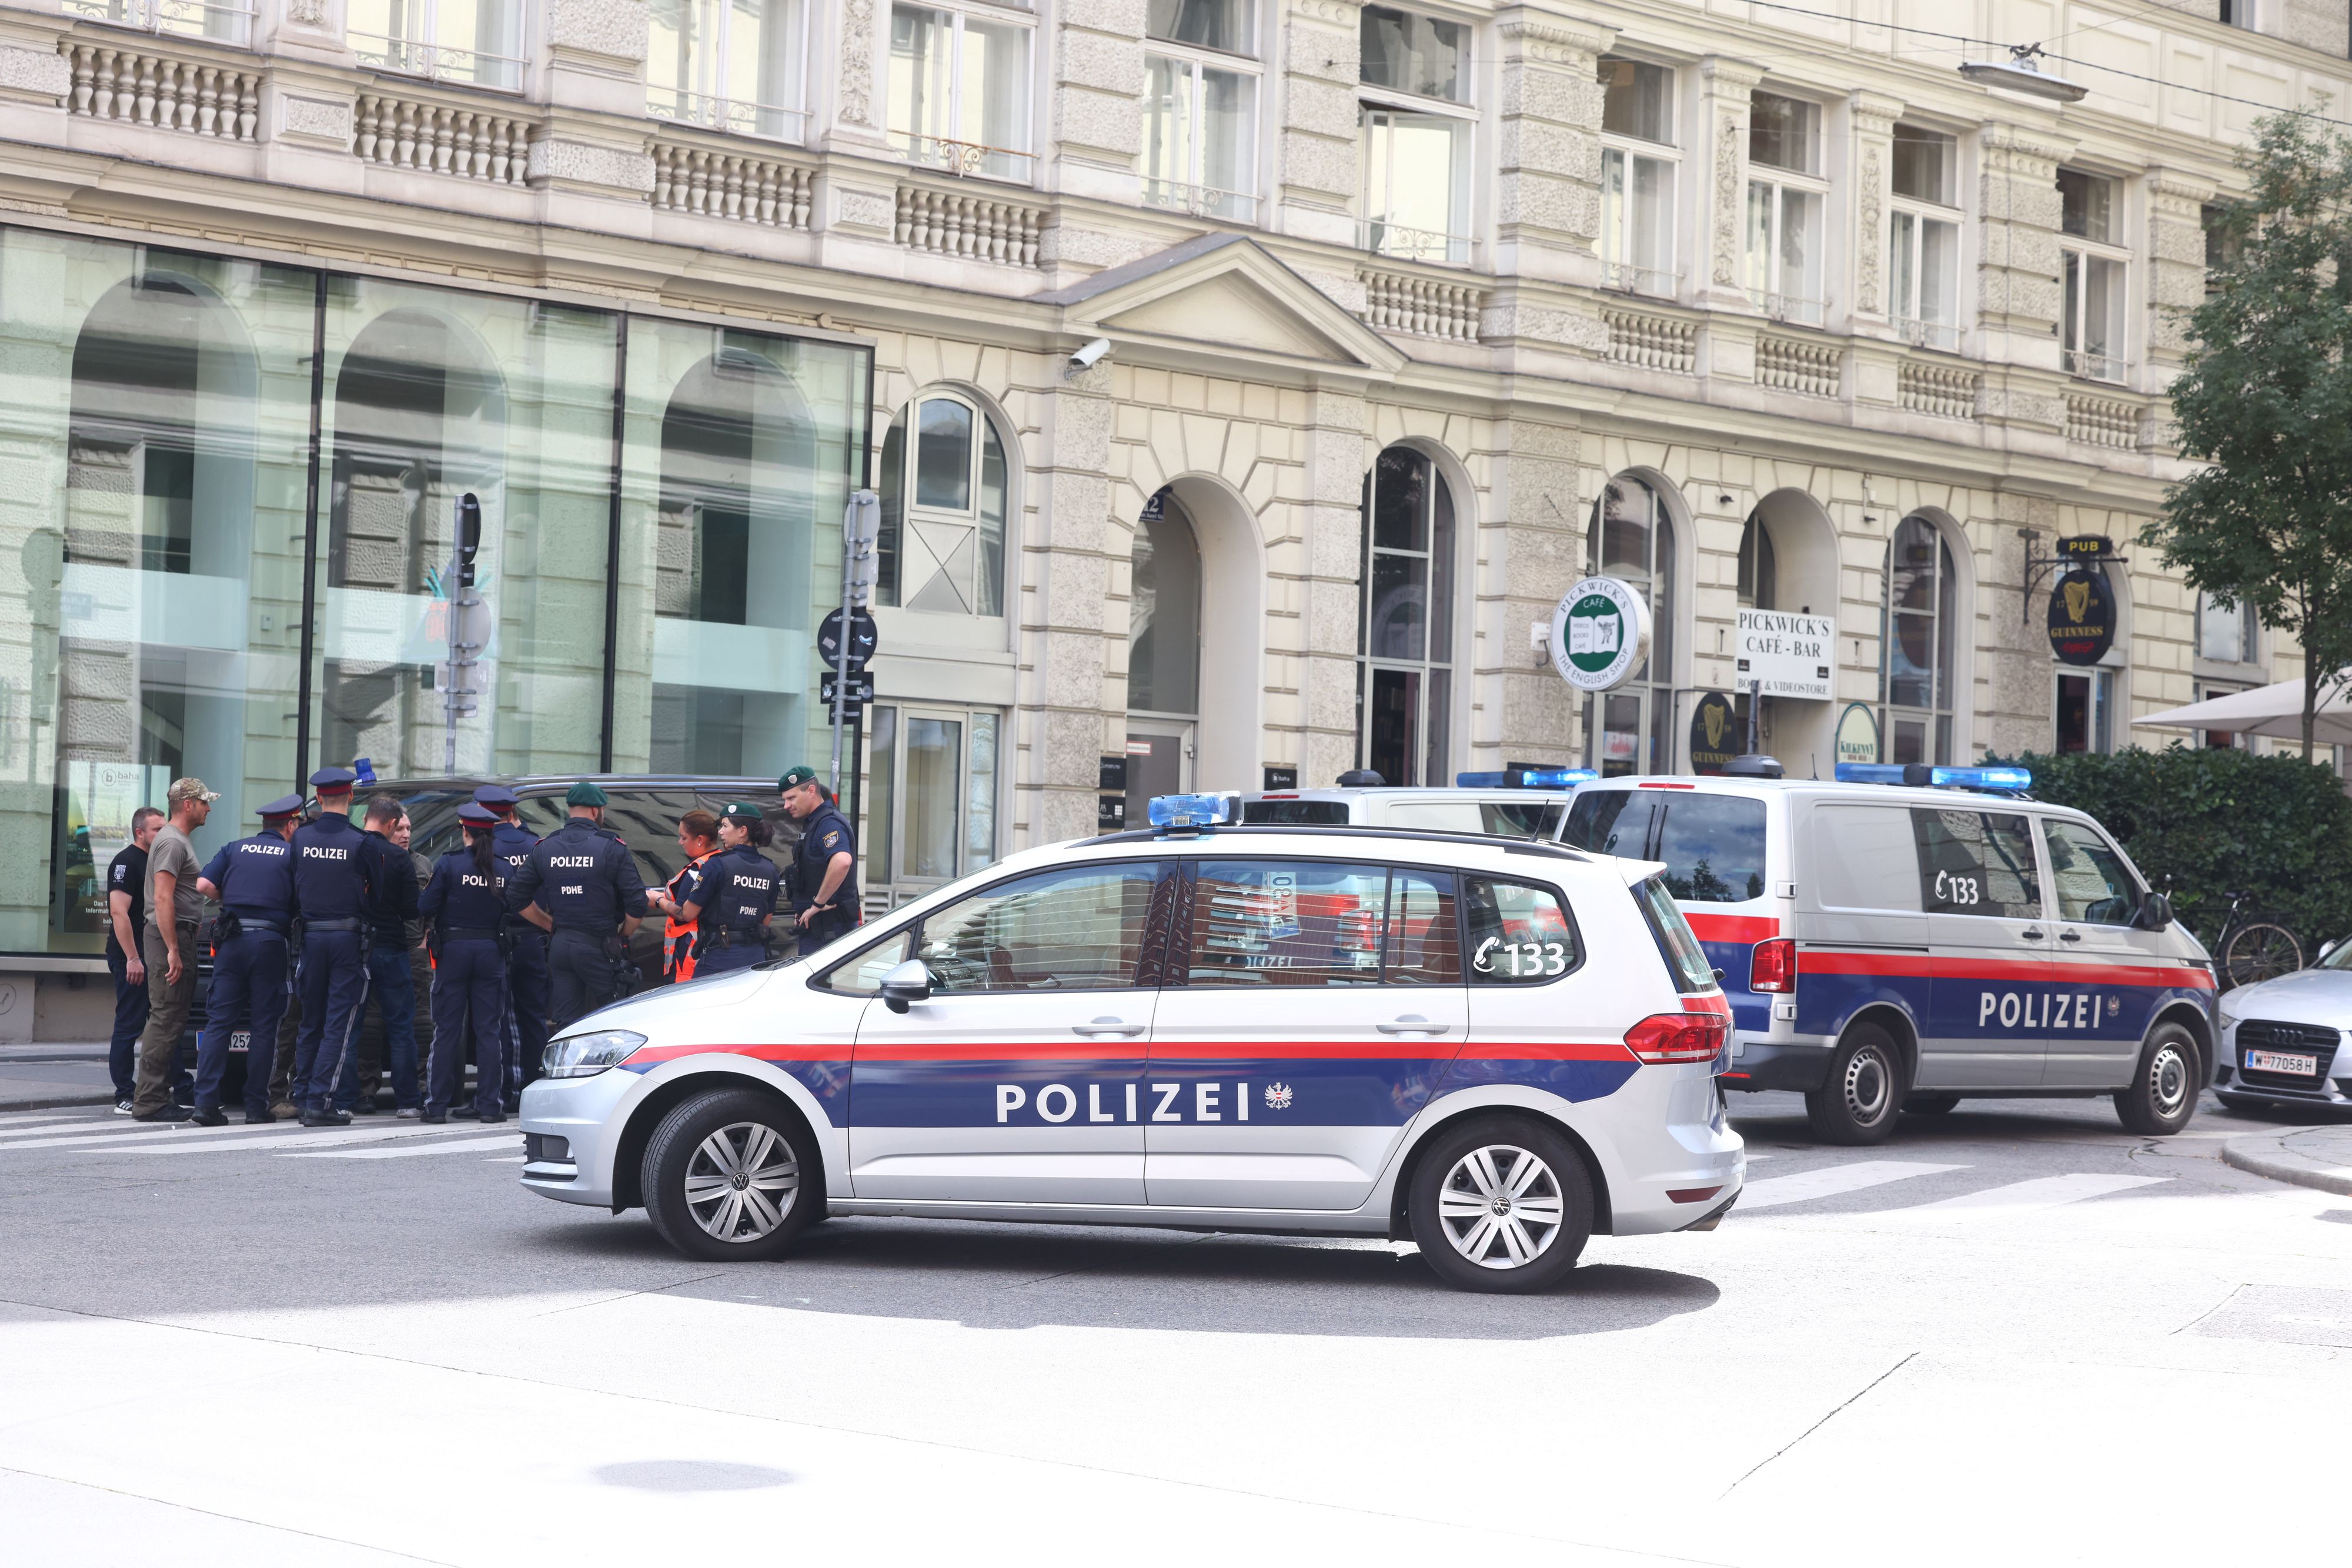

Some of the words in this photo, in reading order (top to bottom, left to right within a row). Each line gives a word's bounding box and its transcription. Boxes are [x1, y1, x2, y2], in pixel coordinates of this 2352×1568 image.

[2069, 541, 2099, 551] PUB
[1560, 581, 1628, 613] PICKWICK'S
[1583, 597, 1605, 609] CAFÉ
[1739, 612, 1829, 637] PICKWICK'S
[2050, 626, 2103, 638] GUINNESS
[1746, 634, 1782, 654] CAFÉ
[1794, 641, 1821, 658] BAR
[1559, 654, 1572, 673] THE
[1571, 670, 1609, 684] ENGLISH
[1610, 648, 1629, 676] SHOP
[1765, 681, 1772, 690] &
[1773, 681, 1828, 695] VIDEOSTORE
[118, 771, 139, 780] baha
[240, 844, 285, 855] POLIZEI
[303, 847, 347, 860] POLIZEI
[550, 856, 593, 867] POLIZEI
[462, 874, 505, 888] POLIEI
[733, 875, 770, 890] POLIZEI
[561, 885, 583, 895] PDHE
[1948, 877, 1979, 904] 133
[739, 905, 757, 915] PDHE
[1504, 942, 1566, 975] 133
[1979, 992, 2102, 1028] POLIZEI
[995, 1082, 1248, 1123] POLIZEI
